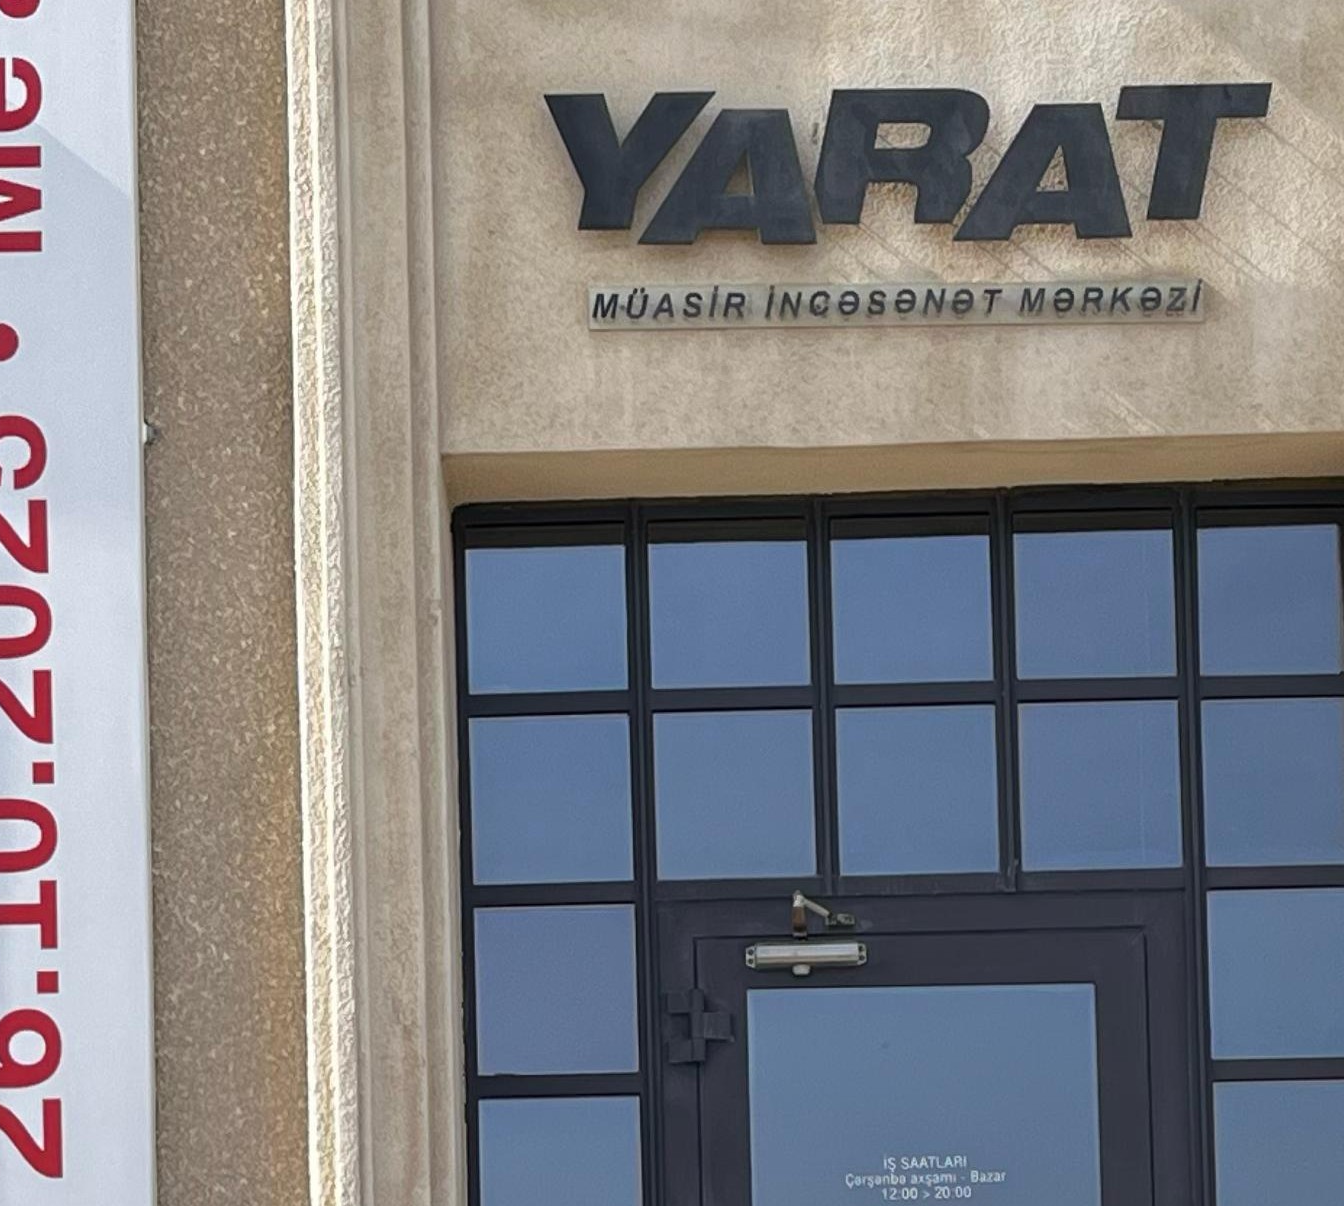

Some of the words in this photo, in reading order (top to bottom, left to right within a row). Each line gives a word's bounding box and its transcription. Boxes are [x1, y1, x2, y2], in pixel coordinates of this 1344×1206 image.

[544, 82, 1272, 245] YARAT
[592, 285, 746, 319] MÜASİR
[765, 285, 1002, 319] İNCƏSƏNƏT
[1019, 278, 1203, 315] MƏRKƏZİ
[901, 1155, 968, 1170] SAATLARI
[970, 1170, 1006, 1183] Bazar
[882, 1187, 918, 1200] 12:00
[934, 1186, 972, 1199] 20:00
